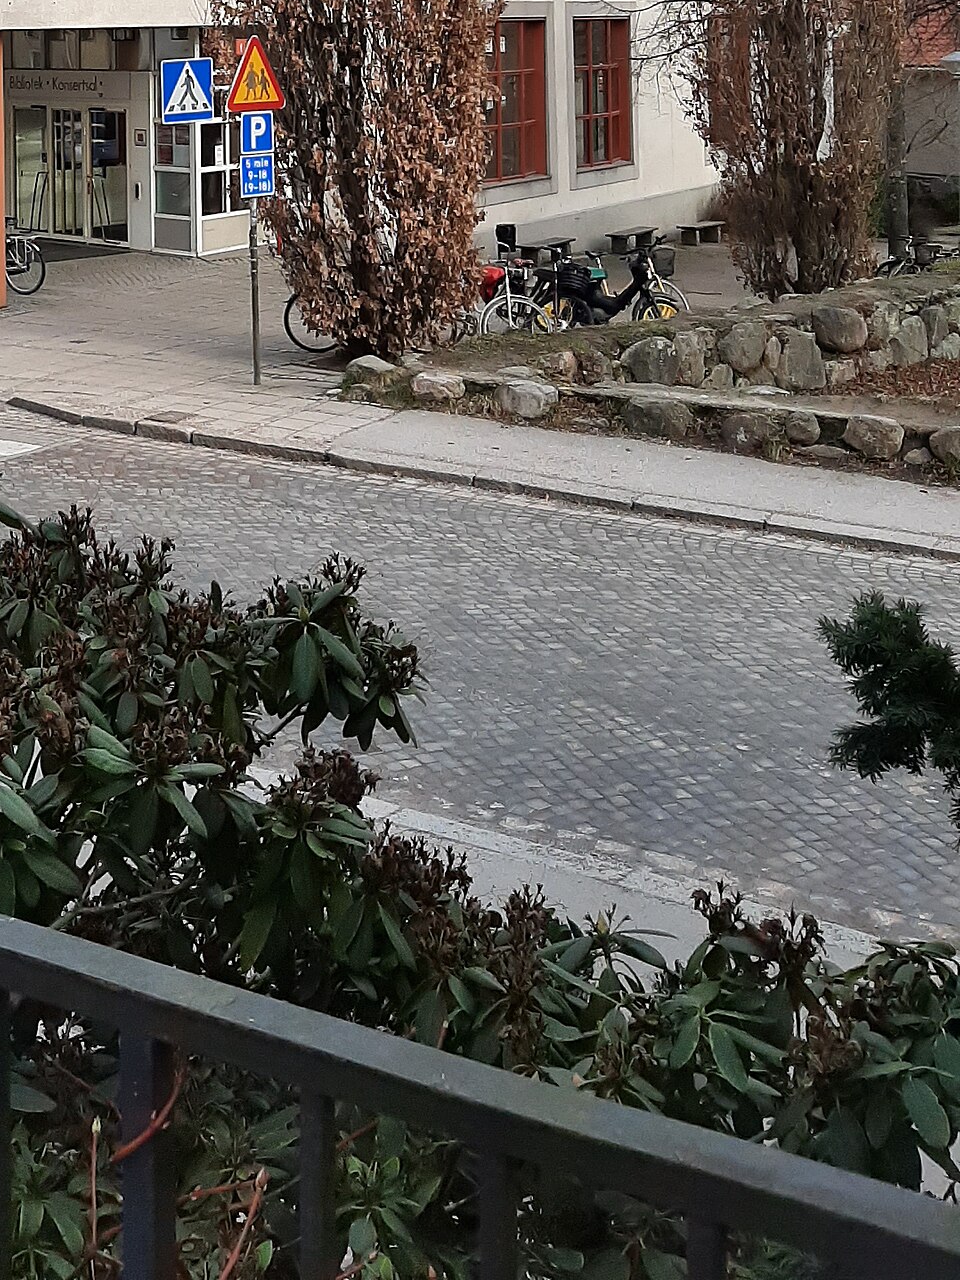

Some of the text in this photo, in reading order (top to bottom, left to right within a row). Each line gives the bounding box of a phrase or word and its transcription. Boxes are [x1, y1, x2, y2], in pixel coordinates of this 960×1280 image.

[250, 116, 267, 149] P
[245, 159, 251, 169] 5
[248, 169, 268, 181] 9-18
[244, 180, 271, 193] (9-18)
